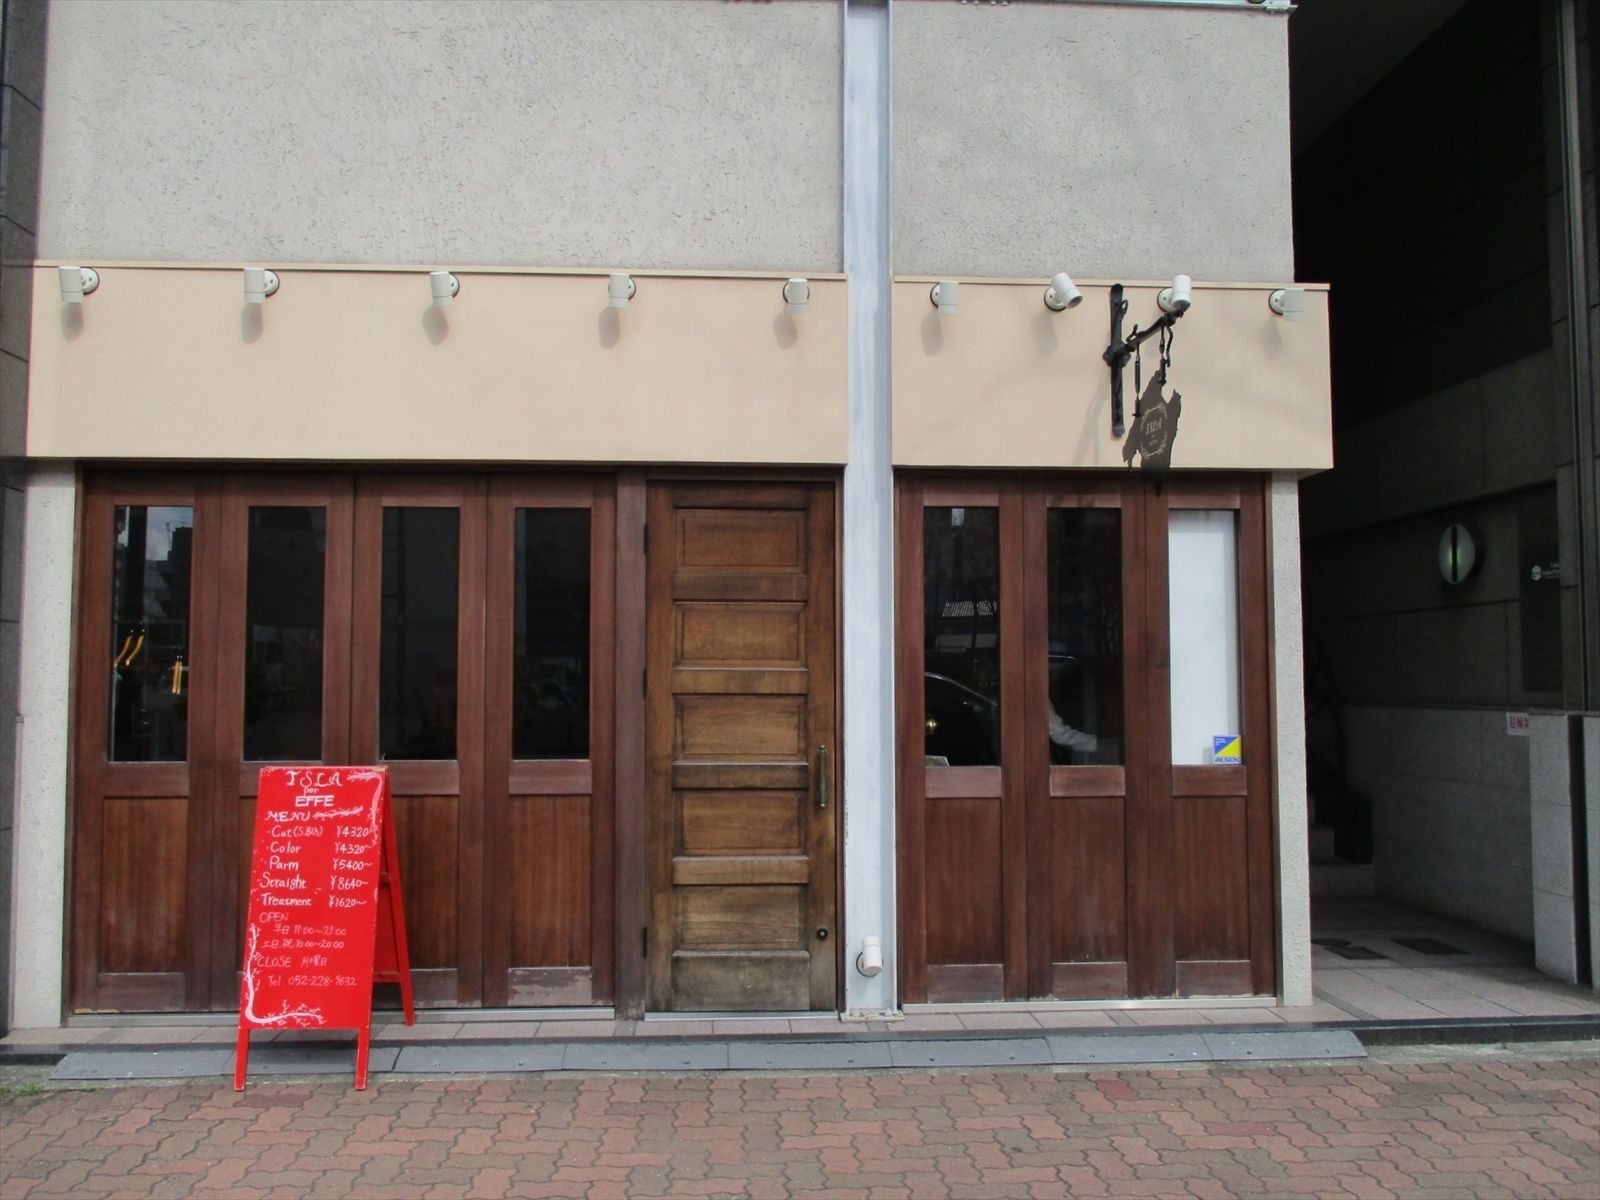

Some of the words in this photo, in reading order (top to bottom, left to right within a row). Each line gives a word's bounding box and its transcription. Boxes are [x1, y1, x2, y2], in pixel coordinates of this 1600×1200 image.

[295, 795, 335, 807] EFFE
[265, 811, 311, 822] MENU
[269, 841, 301, 854] Color
[269, 855, 299, 871] Parm
[260, 871, 307, 890] Straight
[261, 892, 312, 906] Treatment
[259, 912, 289, 924] OPEN
[257, 957, 292, 968] CLOSE
[267, 974, 282, 987] Tel
